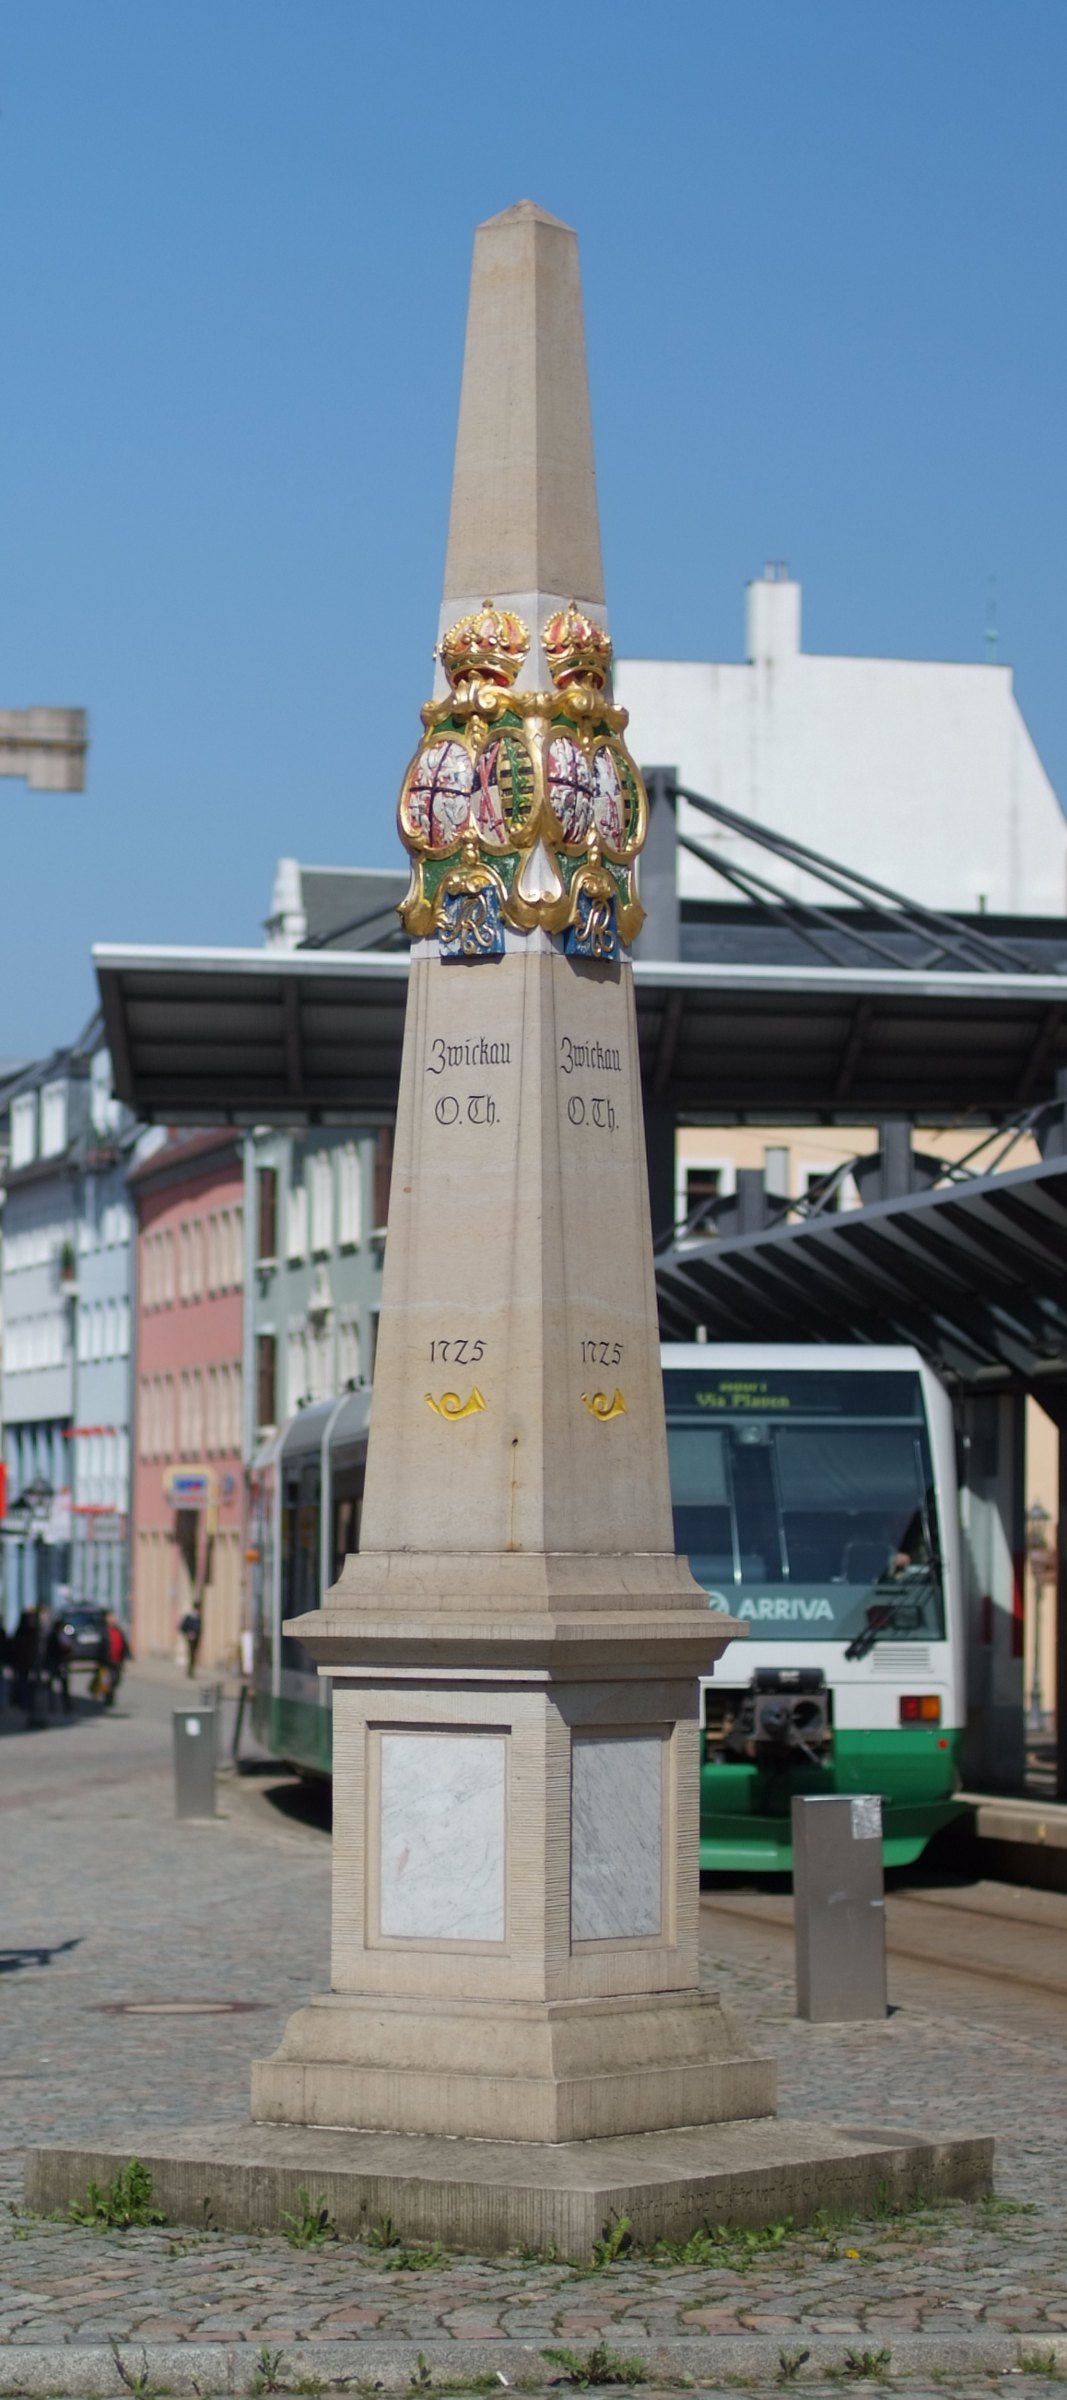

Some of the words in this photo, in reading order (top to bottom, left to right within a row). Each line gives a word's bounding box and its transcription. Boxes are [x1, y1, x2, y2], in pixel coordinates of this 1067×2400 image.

[426, 1036, 512, 1074] Zwickau
[560, 1036, 622, 1074] Zwickau
[430, 1339, 488, 1366] 1725
[580, 1340, 624, 1366] 1725
[738, 1597, 835, 1621] ARRIVA
